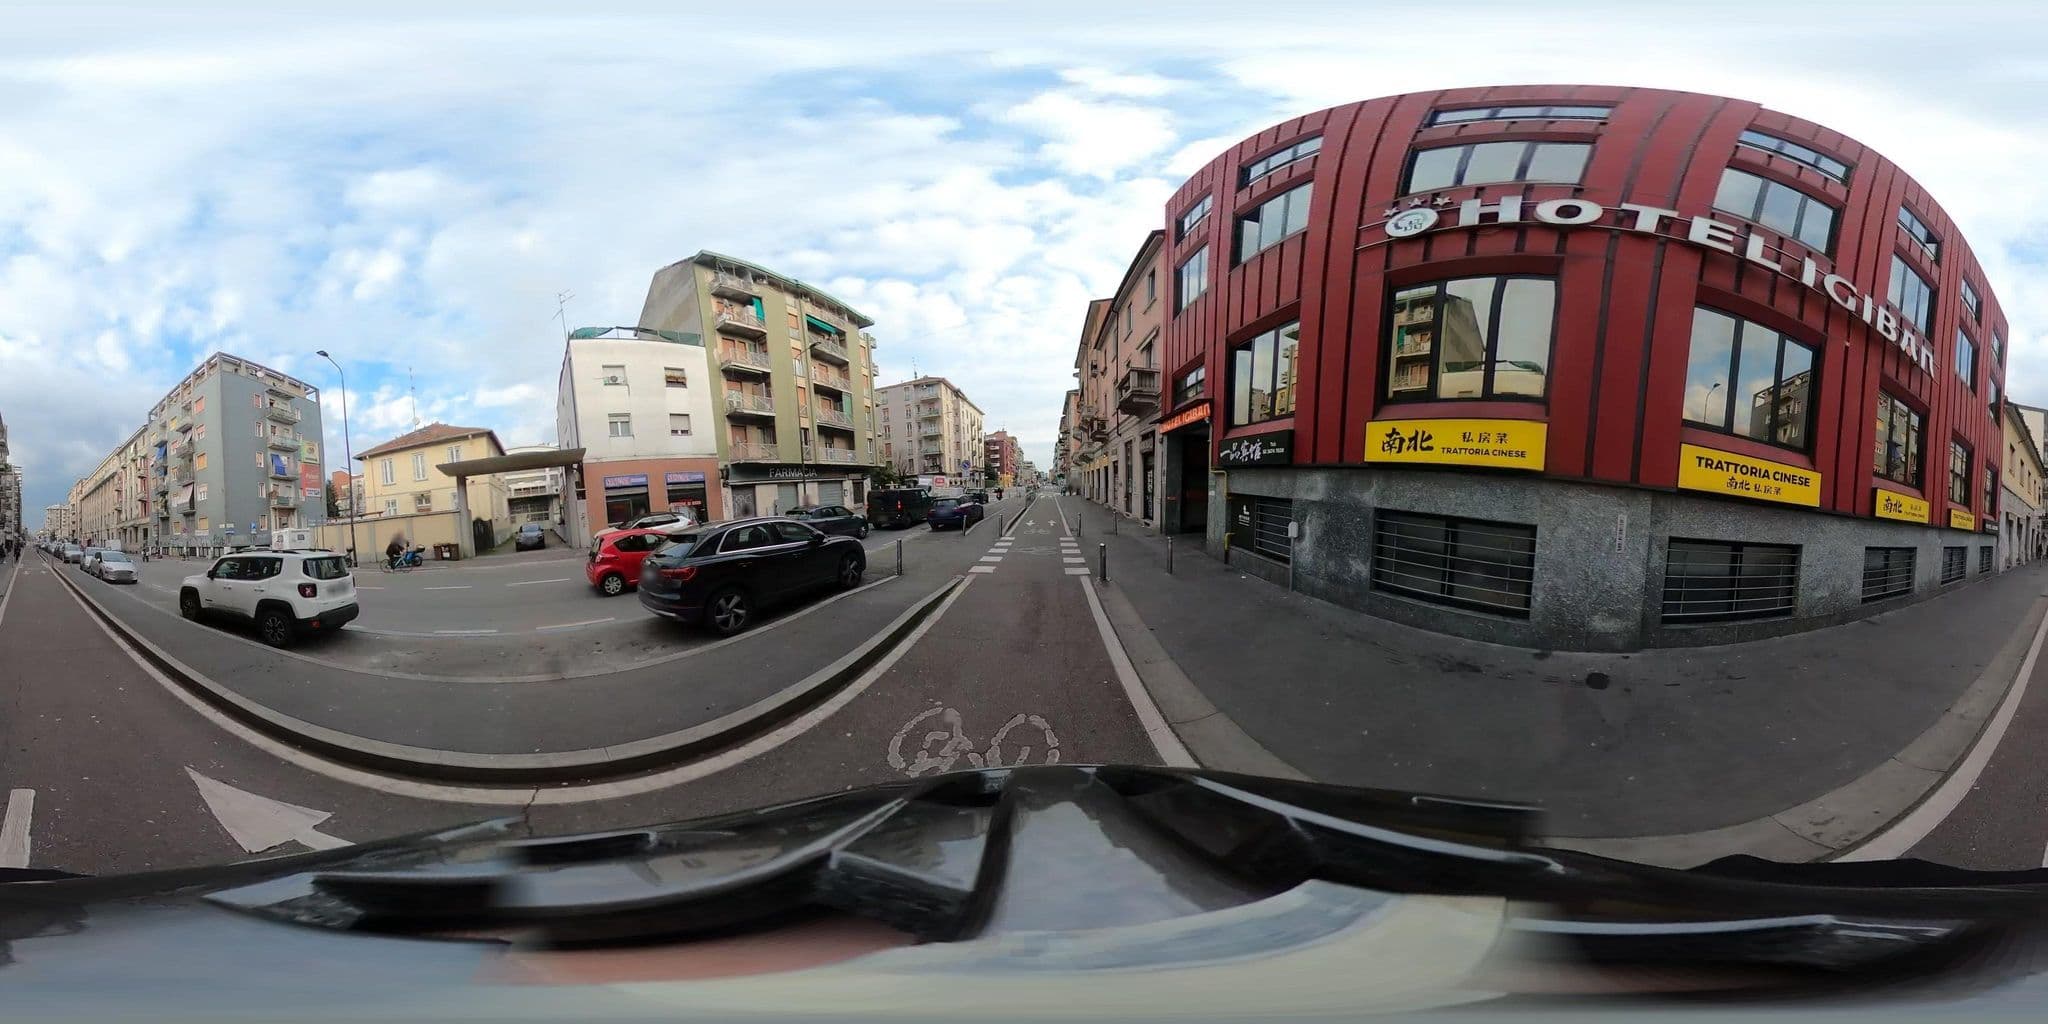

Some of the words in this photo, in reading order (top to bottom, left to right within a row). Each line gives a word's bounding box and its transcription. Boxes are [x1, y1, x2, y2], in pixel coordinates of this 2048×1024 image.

[1459, 195, 1781, 273] HOTEL
[1381, 427, 1434, 456] 南北
[1441, 447, 1490, 456] TRATTORIA
[1492, 449, 1526, 458] CINESE
[769, 468, 818, 478] FARMACIA
[1696, 456, 1770, 480] TRATTORIA
[1773, 471, 1810, 487] CINESE
